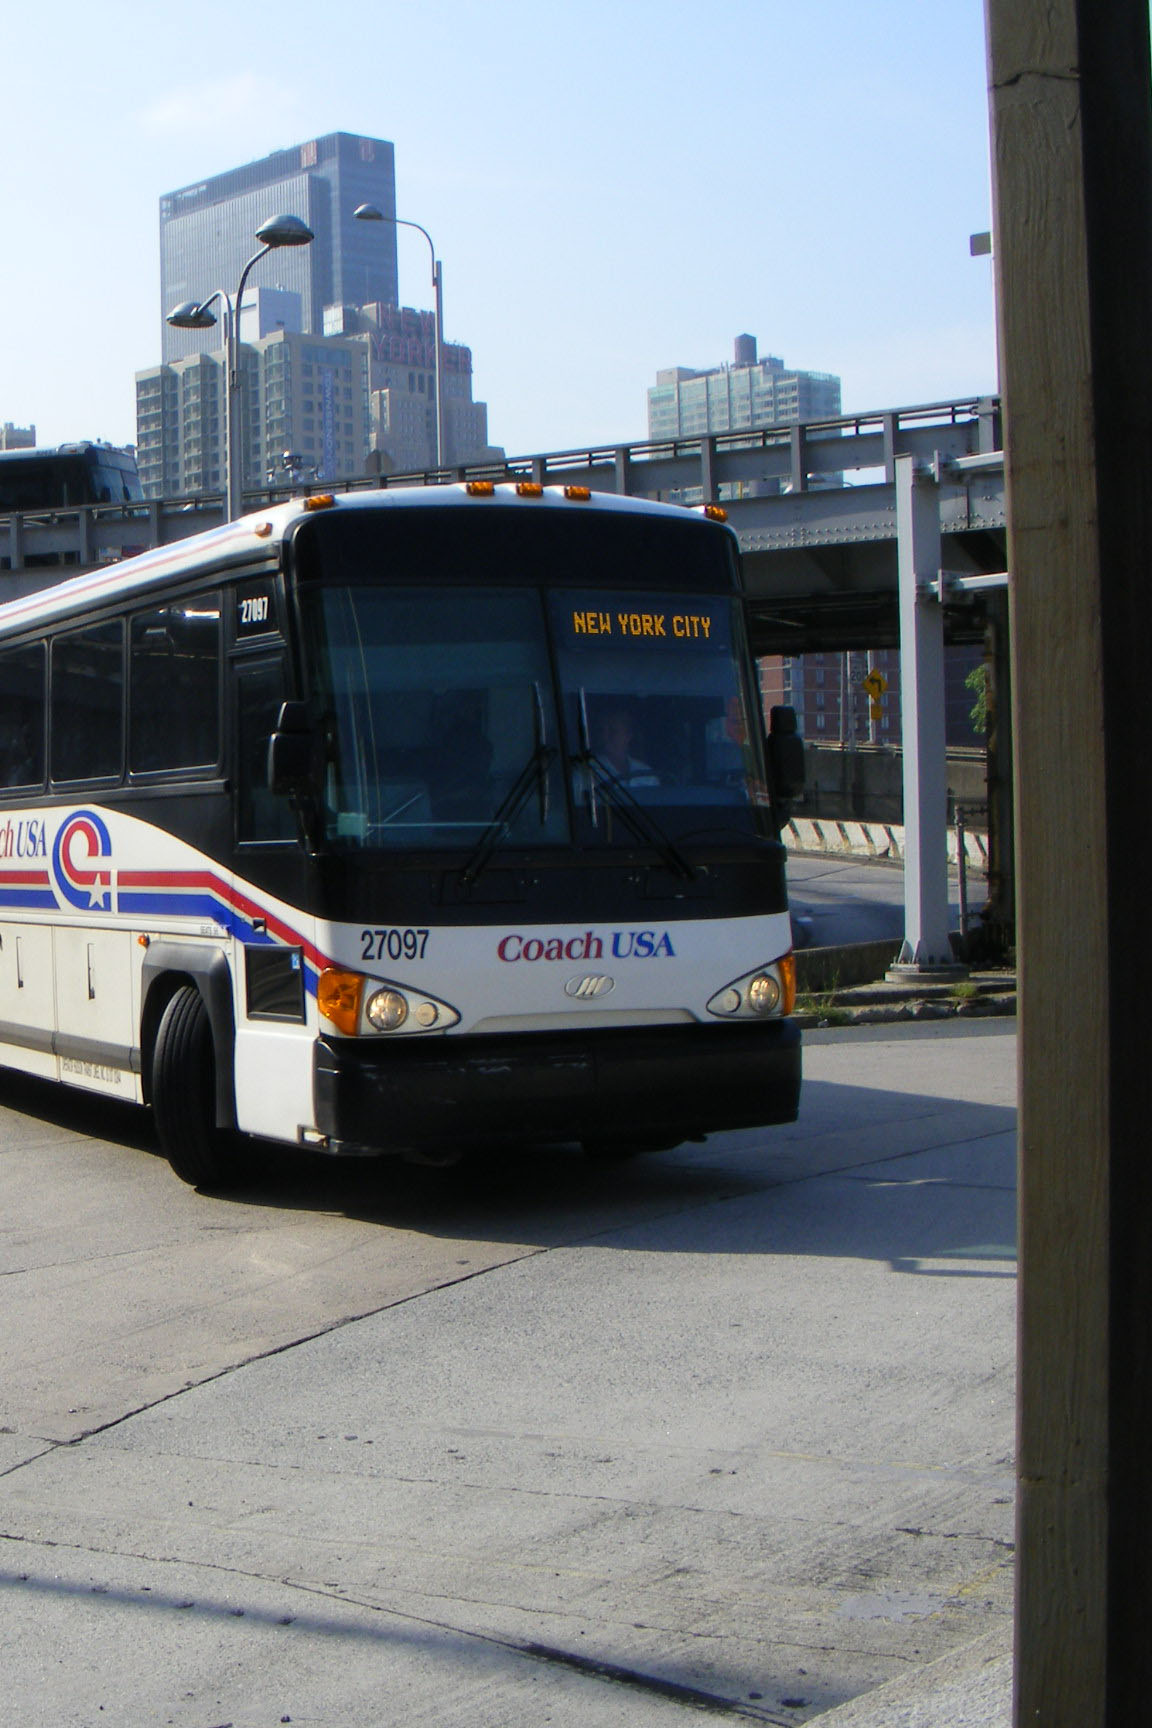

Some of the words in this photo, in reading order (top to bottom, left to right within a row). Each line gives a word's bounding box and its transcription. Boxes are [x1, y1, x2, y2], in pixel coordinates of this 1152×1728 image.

[238, 596, 269, 623] 27097
[573, 611, 612, 635] NEW
[617, 613, 667, 636] YORK
[672, 615, 712, 639] CITY
[16, 819, 48, 859] USA
[361, 928, 431, 961] 27097
[497, 931, 603, 962] Coach
[611, 932, 676, 958] USA
